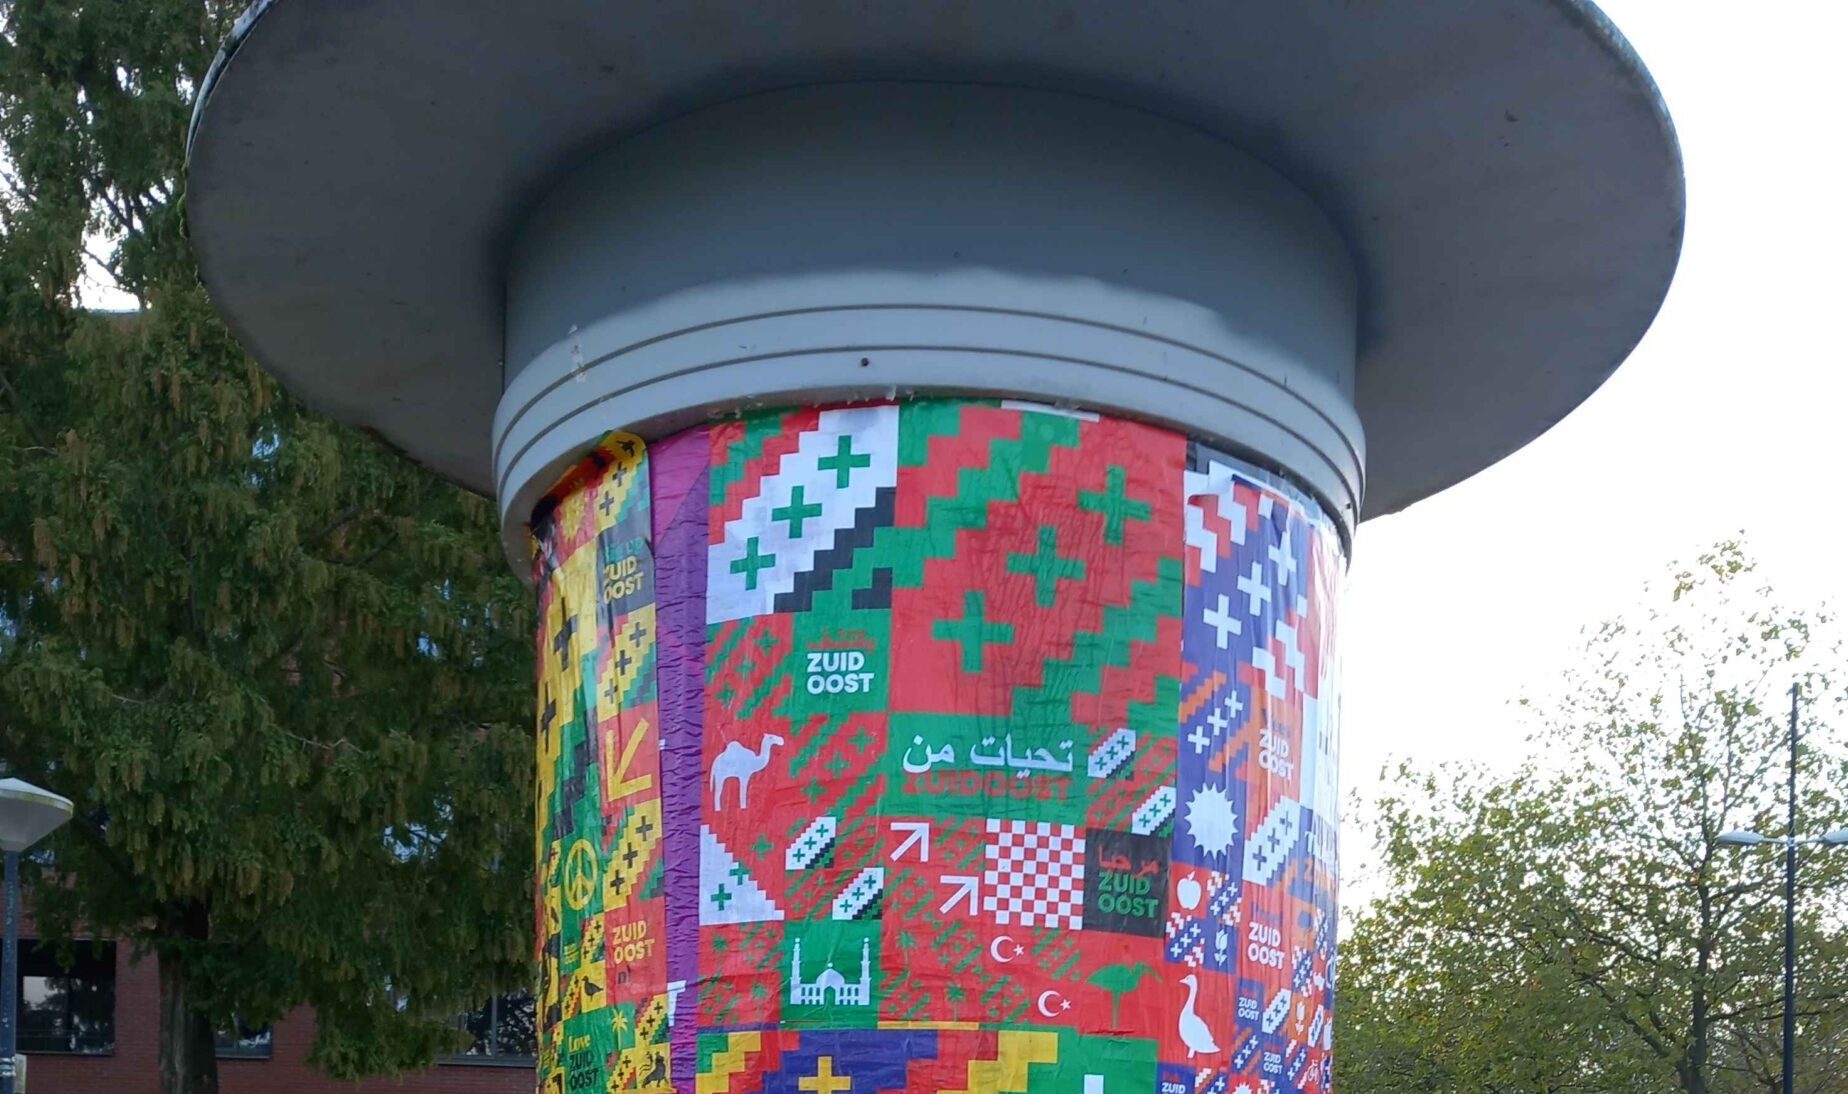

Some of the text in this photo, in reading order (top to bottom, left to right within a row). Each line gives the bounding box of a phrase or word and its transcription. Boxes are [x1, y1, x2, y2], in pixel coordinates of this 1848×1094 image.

[604, 571, 644, 604] OOST
[807, 651, 865, 673] ZUID
[807, 673, 875, 695] OOST
[902, 733, 1073, 779] تحيات من
[902, 769, 1074, 803] ZUIDOOST
[1098, 871, 1151, 896] ZUID
[1097, 893, 1159, 918] OOST
[612, 920, 647, 945] ZUID
[1248, 921, 1281, 948] ZUID
[613, 938, 656, 965] OOST
[1247, 942, 1286, 970] OOST
[1238, 997, 1258, 1010] ZUID
[1238, 1008, 1260, 1021] OOST
[569, 1050, 594, 1072] ZUID
[569, 1068, 599, 1091] OOST
[1161, 1082, 1186, 1094] ZUID
